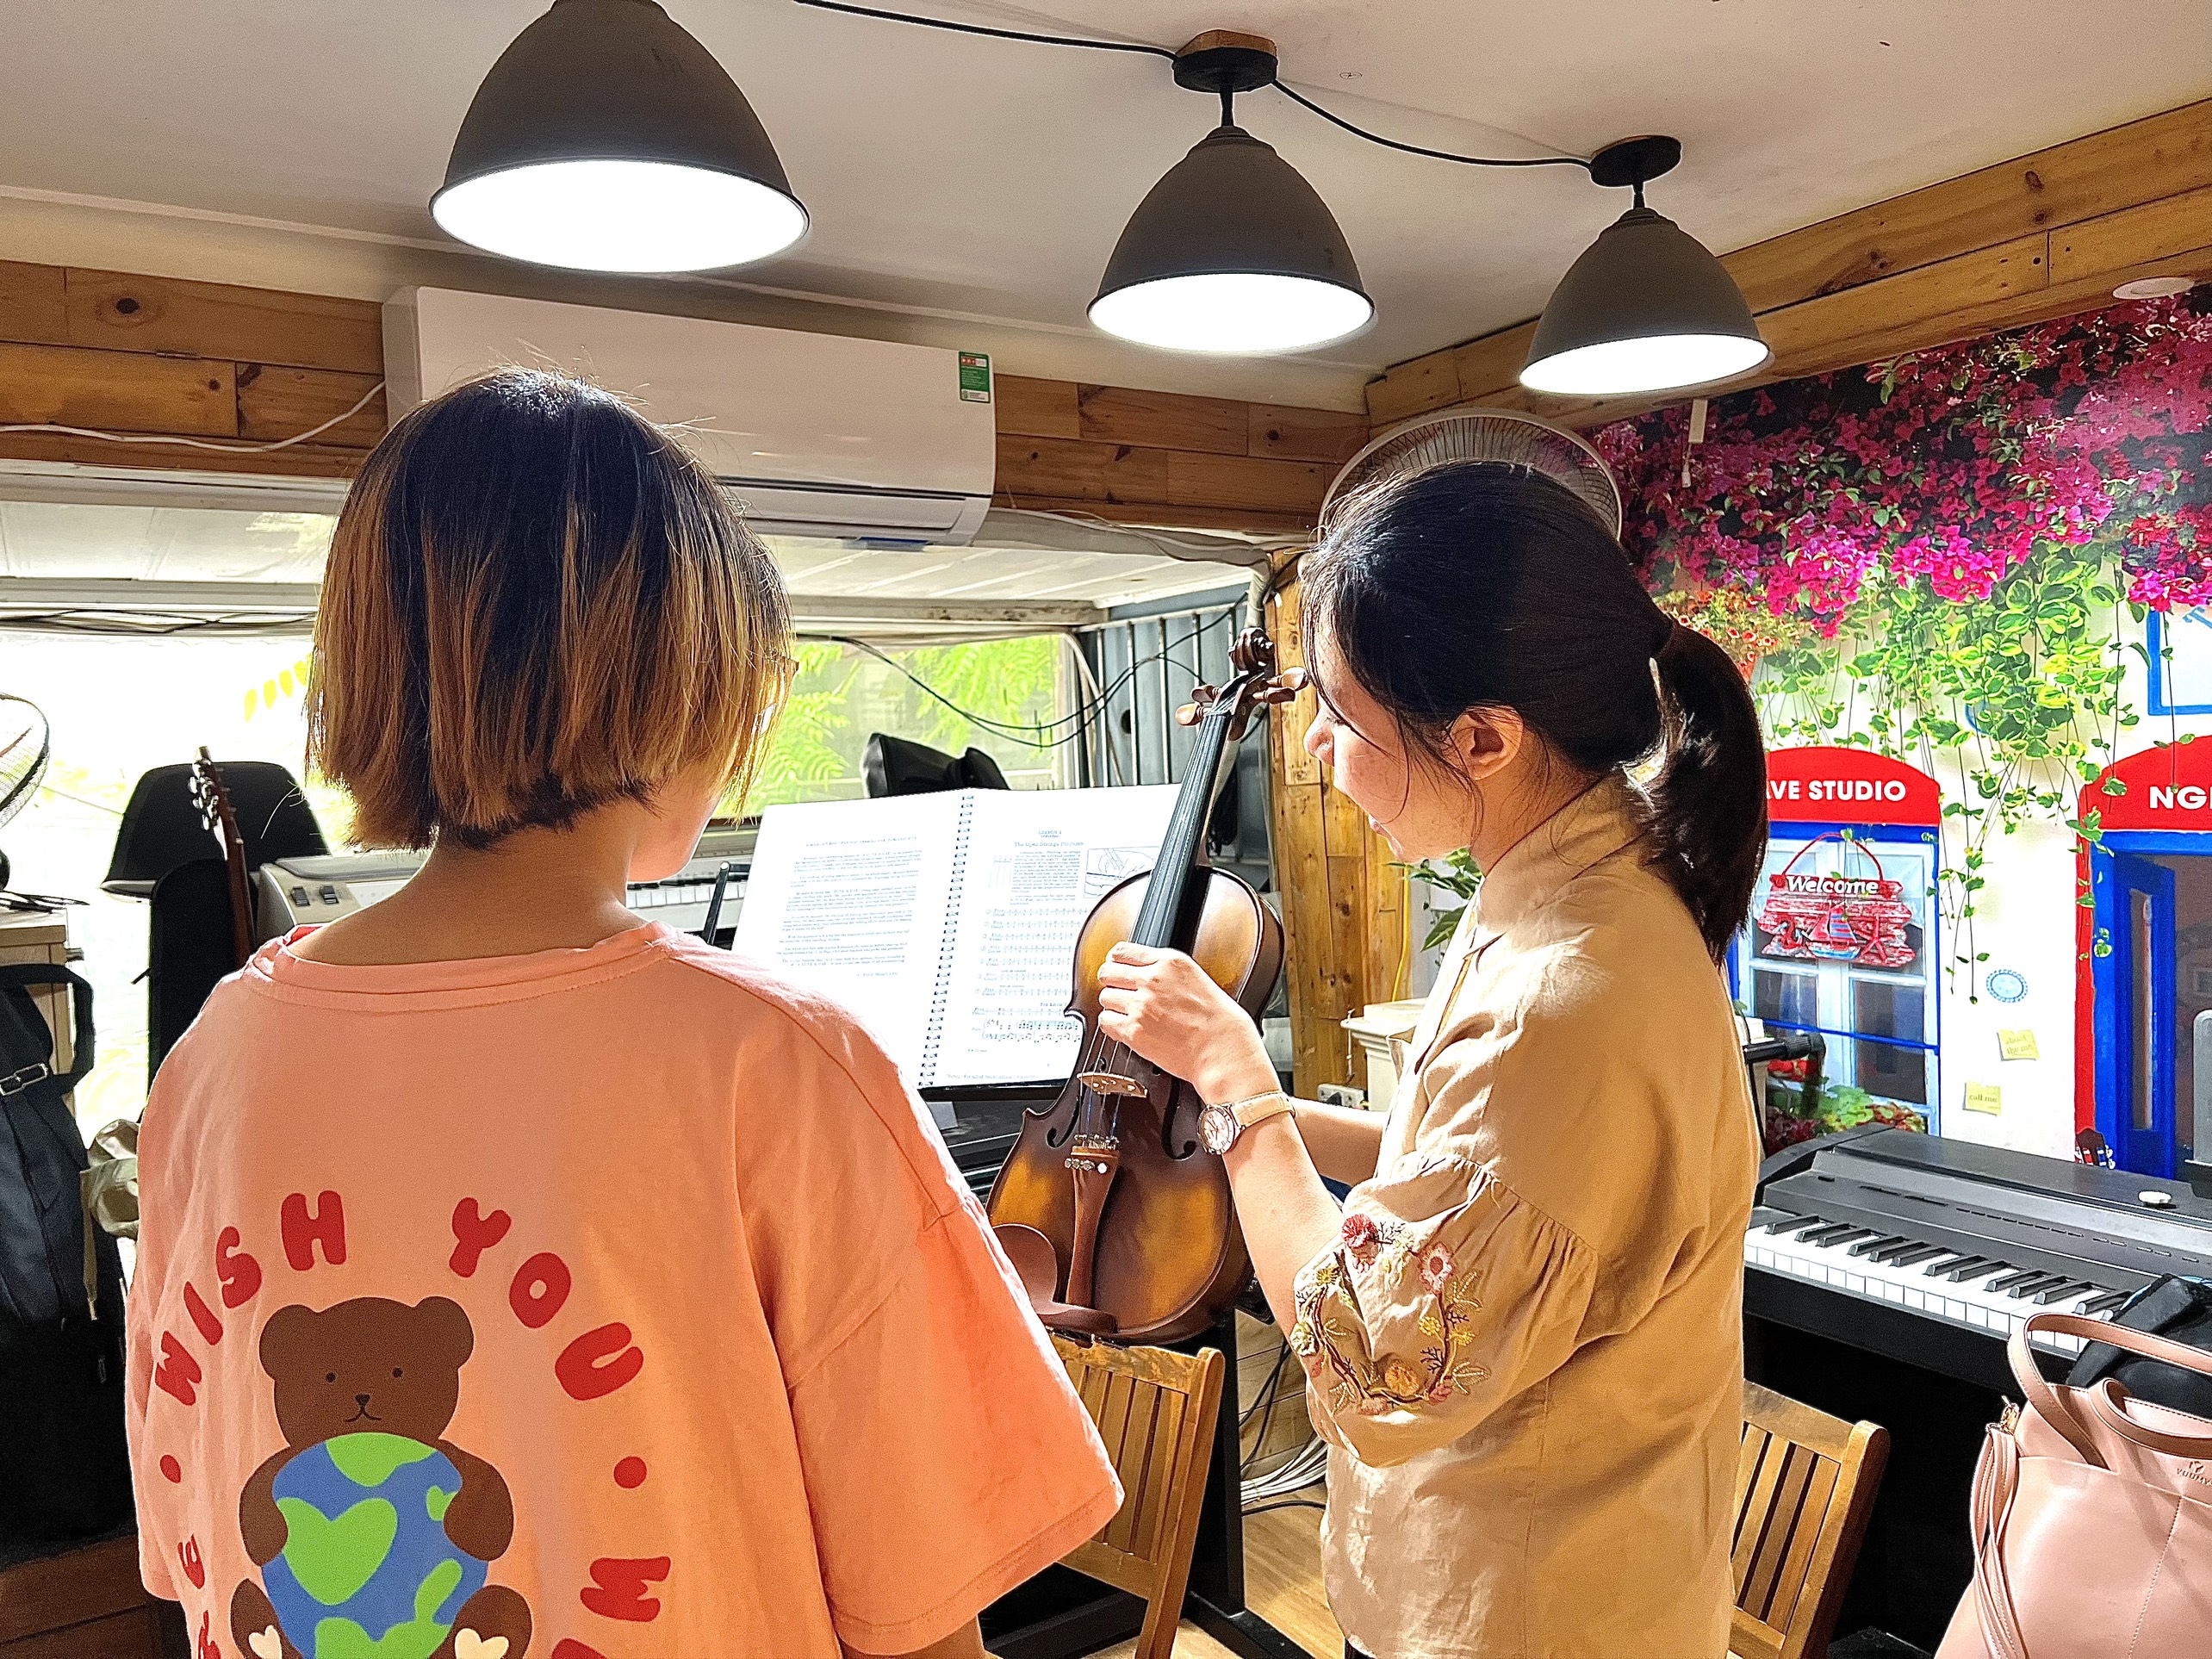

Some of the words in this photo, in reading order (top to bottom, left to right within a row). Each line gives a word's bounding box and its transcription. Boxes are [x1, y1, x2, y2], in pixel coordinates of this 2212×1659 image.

[1808, 780, 1906, 802] STUDIO
[2149, 786, 2212, 810] NG
[1786, 876, 1879, 895] Welcome
[155, 1190, 347, 1406] WISH
[449, 1196, 644, 1401] YOU
